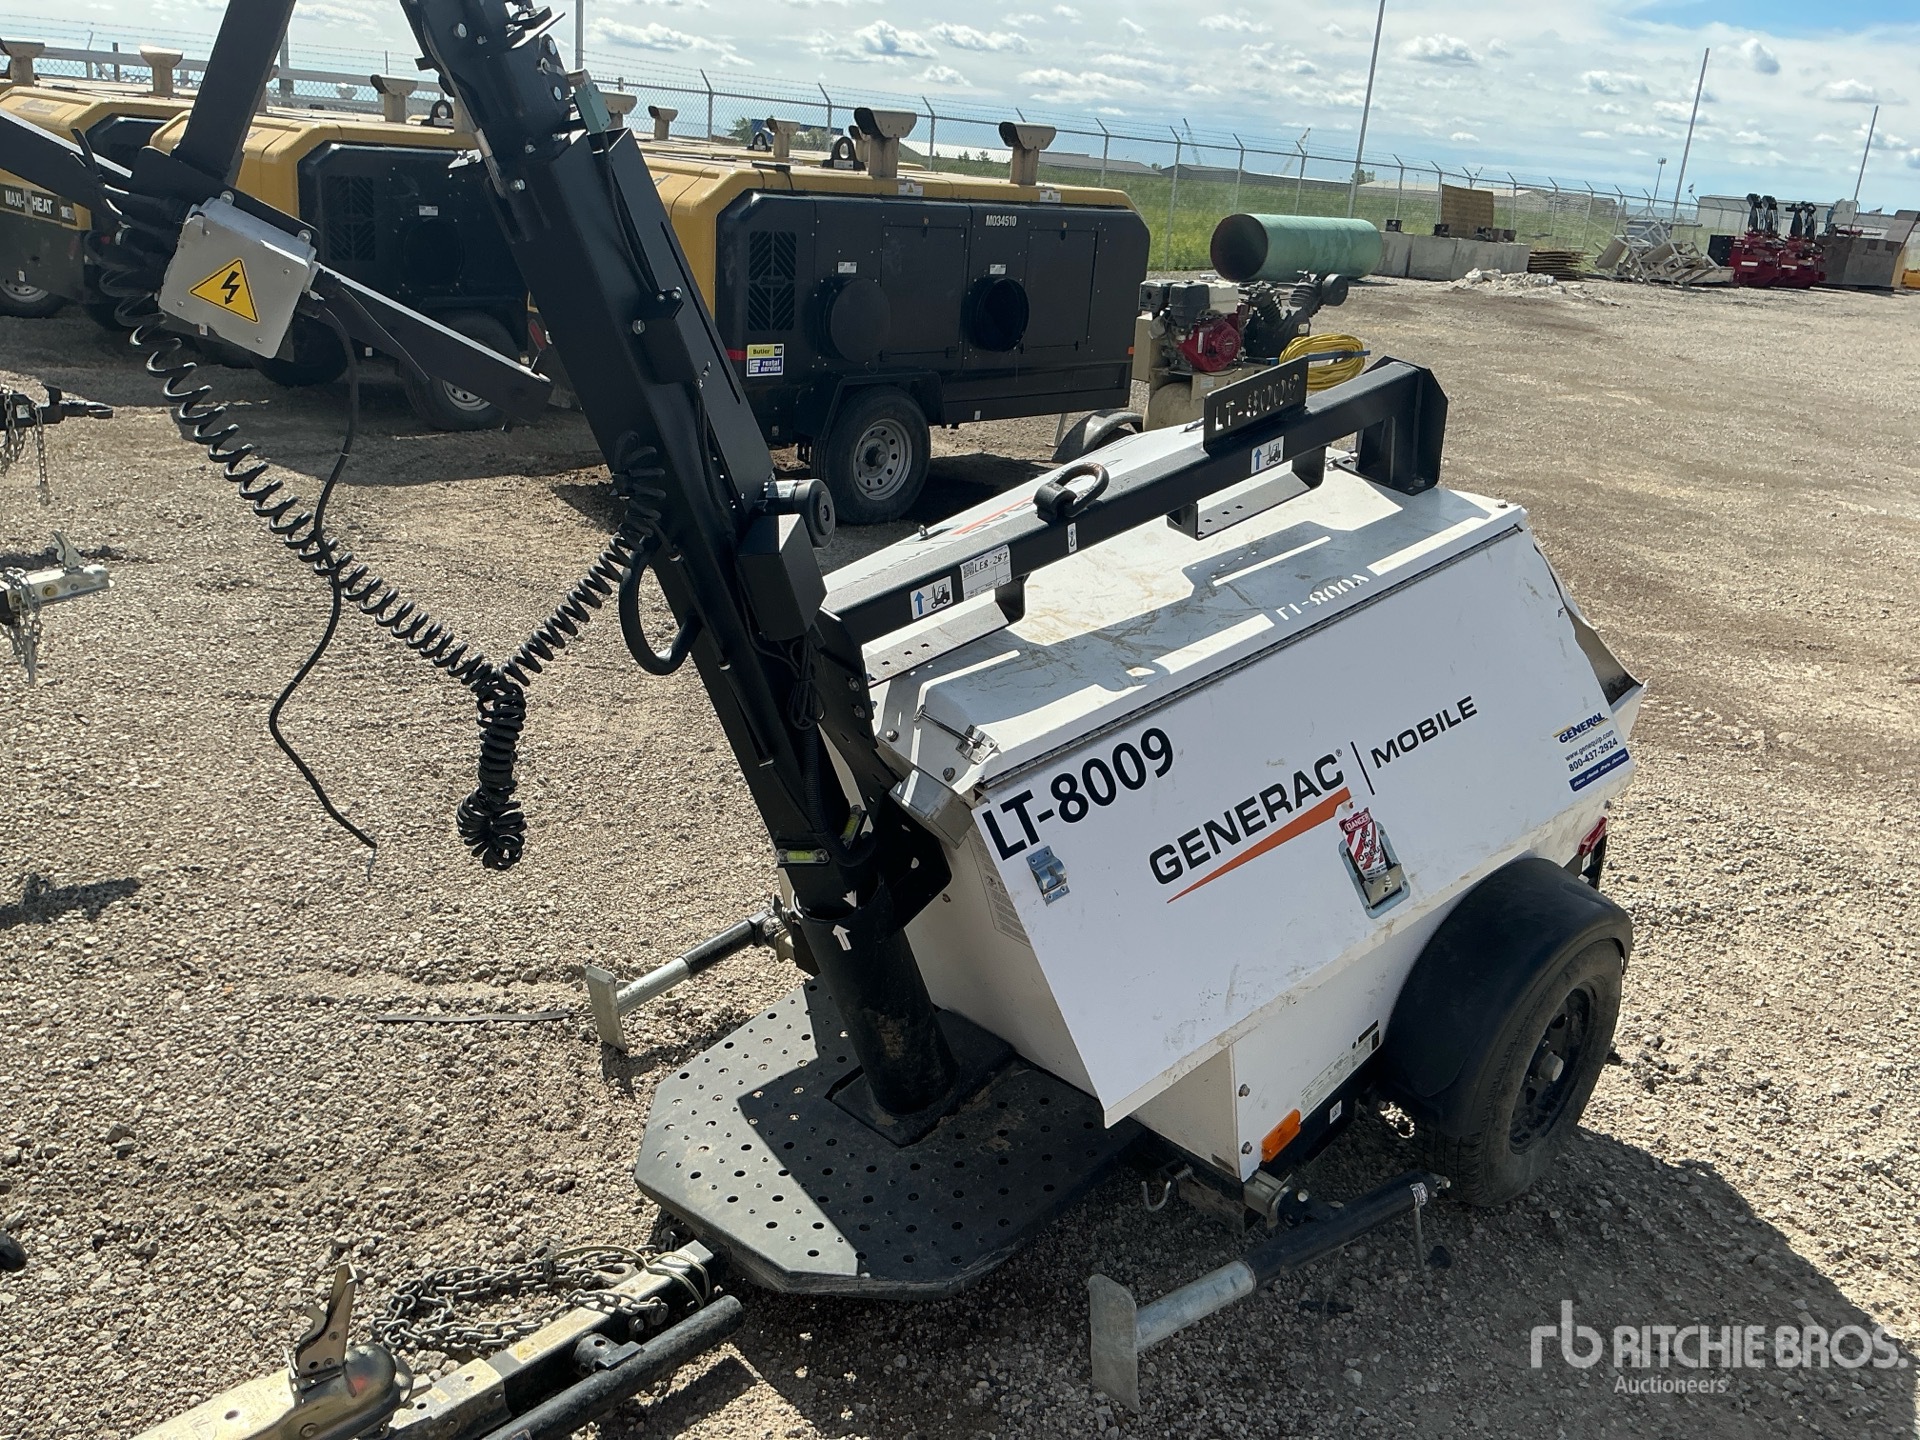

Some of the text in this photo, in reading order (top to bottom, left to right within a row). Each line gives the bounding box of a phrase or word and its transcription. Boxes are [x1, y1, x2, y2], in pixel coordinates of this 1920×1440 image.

[985, 214, 1017, 227] M034510
[1370, 695, 1478, 769] MOBILE
[1559, 712, 1606, 744] GENERAL
[1565, 729, 1614, 761] www.genequip.com
[1568, 737, 1618, 772] 800-437-2924
[982, 727, 1174, 861] LT-8009
